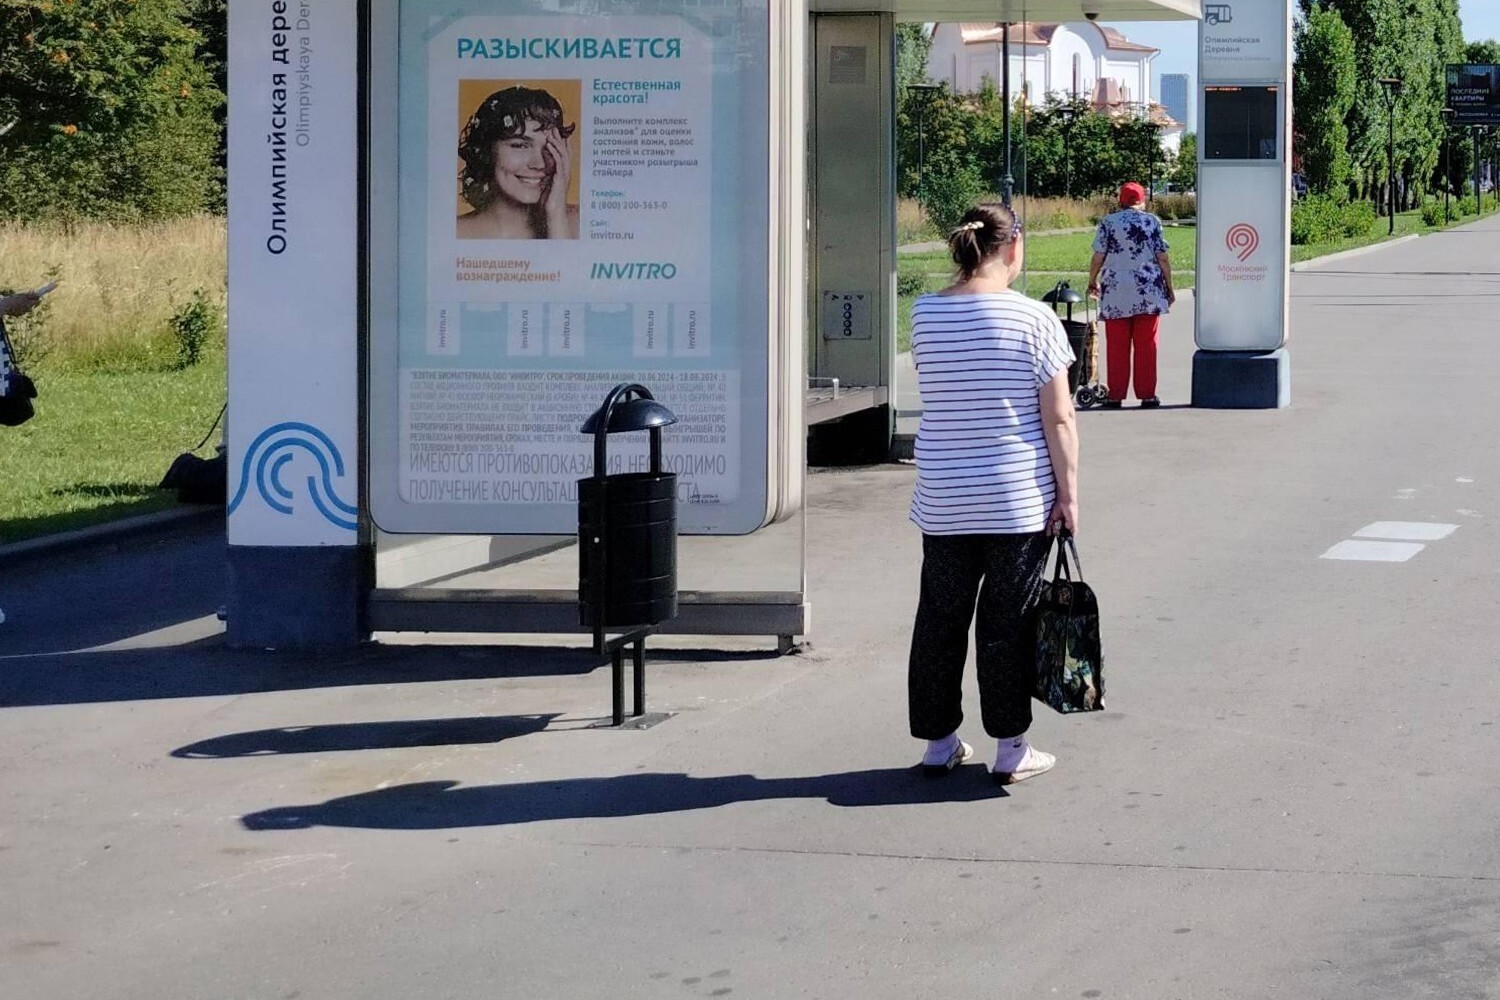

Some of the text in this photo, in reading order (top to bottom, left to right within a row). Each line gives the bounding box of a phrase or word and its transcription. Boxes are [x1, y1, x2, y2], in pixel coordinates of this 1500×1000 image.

[1204, 35, 1261, 43] Олимпийская
[456, 38, 682, 59] РАЗЫСКИВАЕТСЯ
[1204, 45, 1240, 54] Деревня
[593, 79, 681, 91] Естественная
[295, 37, 312, 147] Olimpiyskaya
[593, 92, 649, 105] красота!
[593, 117, 643, 126] Выполните
[641, 138, 666, 147] кожи,
[601, 147, 630, 156] ногтей
[267, 73, 288, 255] Олимпийская
[593, 159, 698, 167] участником розыгрыша
[593, 168, 633, 177] стайлера
[598, 201, 621, 210] (800)
[591, 230, 635, 240] invitro.ru
[456, 258, 531, 270] Нашедшему
[1217, 264, 1268, 272] Московский
[456, 270, 562, 283] вознаграждение!
[590, 262, 677, 280] INVITRO
[1222, 272, 1266, 282] Транспорт
[439, 309, 447, 348] invitro.ru
[521, 309, 529, 349] invitro.ru
[563, 310, 571, 350] invitro.ru
[646, 310, 656, 350] invitro.ru
[687, 310, 696, 350] invitro.ru
[467, 423, 505, 431] ПРАВИЛАХ
[507, 423, 520, 431] ЕГО
[663, 423, 712, 433] ВЫИГРЫШЕЙ
[715, 425, 726, 433] ПО
[681, 435, 719, 443] INVITRO.RU
[411, 443, 420, 451] ПО
[410, 453, 474, 474] ИМЕЮТСЯ
[410, 480, 490, 502] ПОЛУЧЕНИЕ
